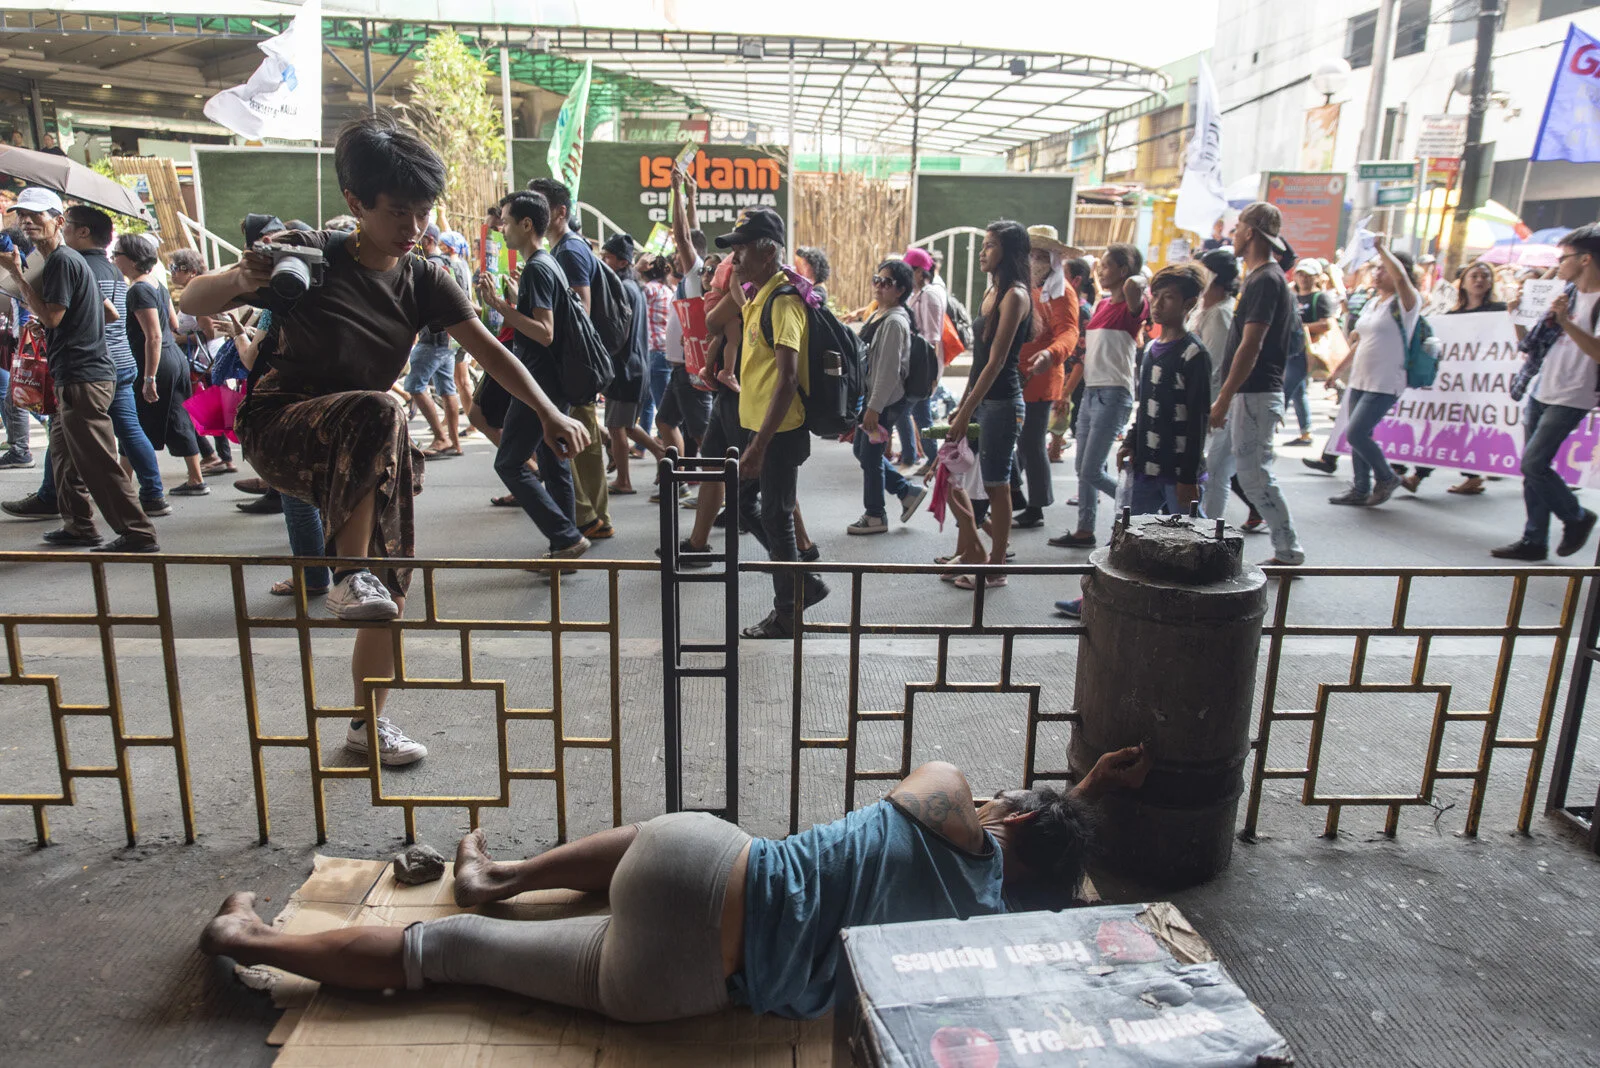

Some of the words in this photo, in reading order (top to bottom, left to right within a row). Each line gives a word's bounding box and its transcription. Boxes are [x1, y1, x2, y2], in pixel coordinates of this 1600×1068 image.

[1439, 372, 1466, 392] SA
[1471, 372, 1517, 392] MA
[892, 946, 998, 973] Apples
[1004, 940, 1093, 964] Fresh
[1109, 1010, 1224, 1044] Apples
